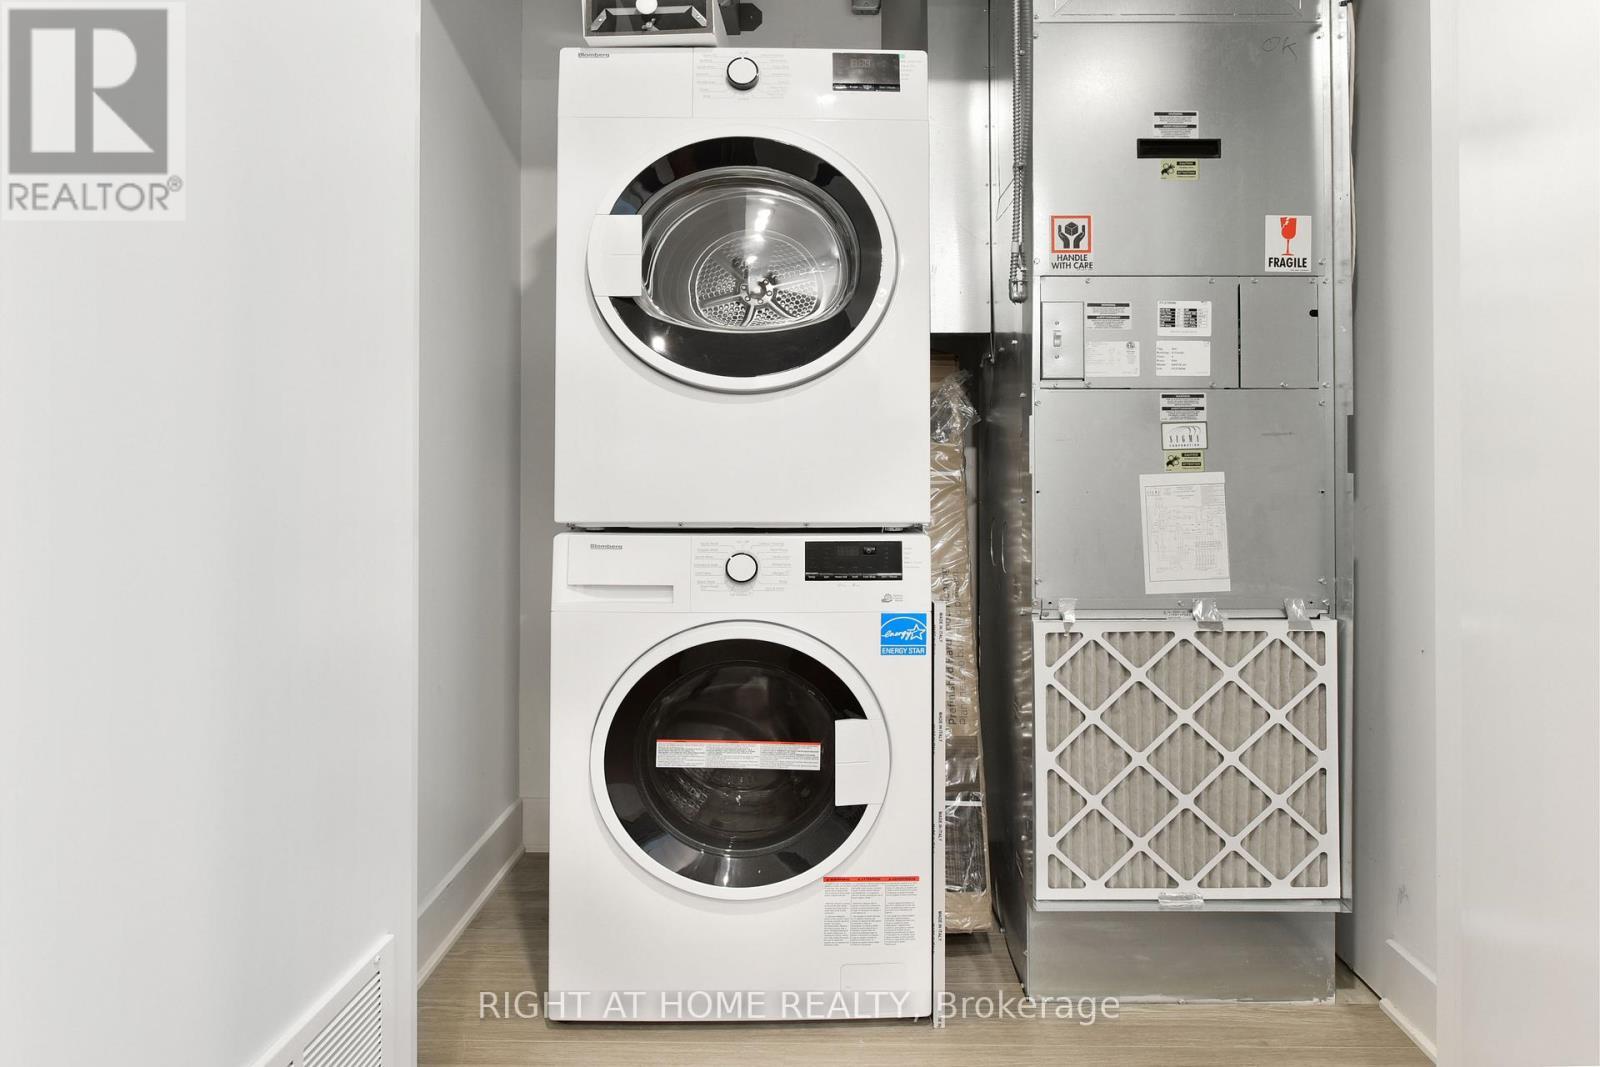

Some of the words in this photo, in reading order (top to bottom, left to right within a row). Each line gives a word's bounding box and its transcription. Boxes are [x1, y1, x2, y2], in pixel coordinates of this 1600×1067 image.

[1056, 254, 1088, 262] HANDLE
[1051, 262, 1073, 270] WITH
[1074, 262, 1094, 270] CARE
[1268, 257, 1308, 269] FRAGILE
[590, 543, 623, 551] Blomberg
[882, 647, 907, 655] ENERGY
[908, 647, 926, 655] STAR
